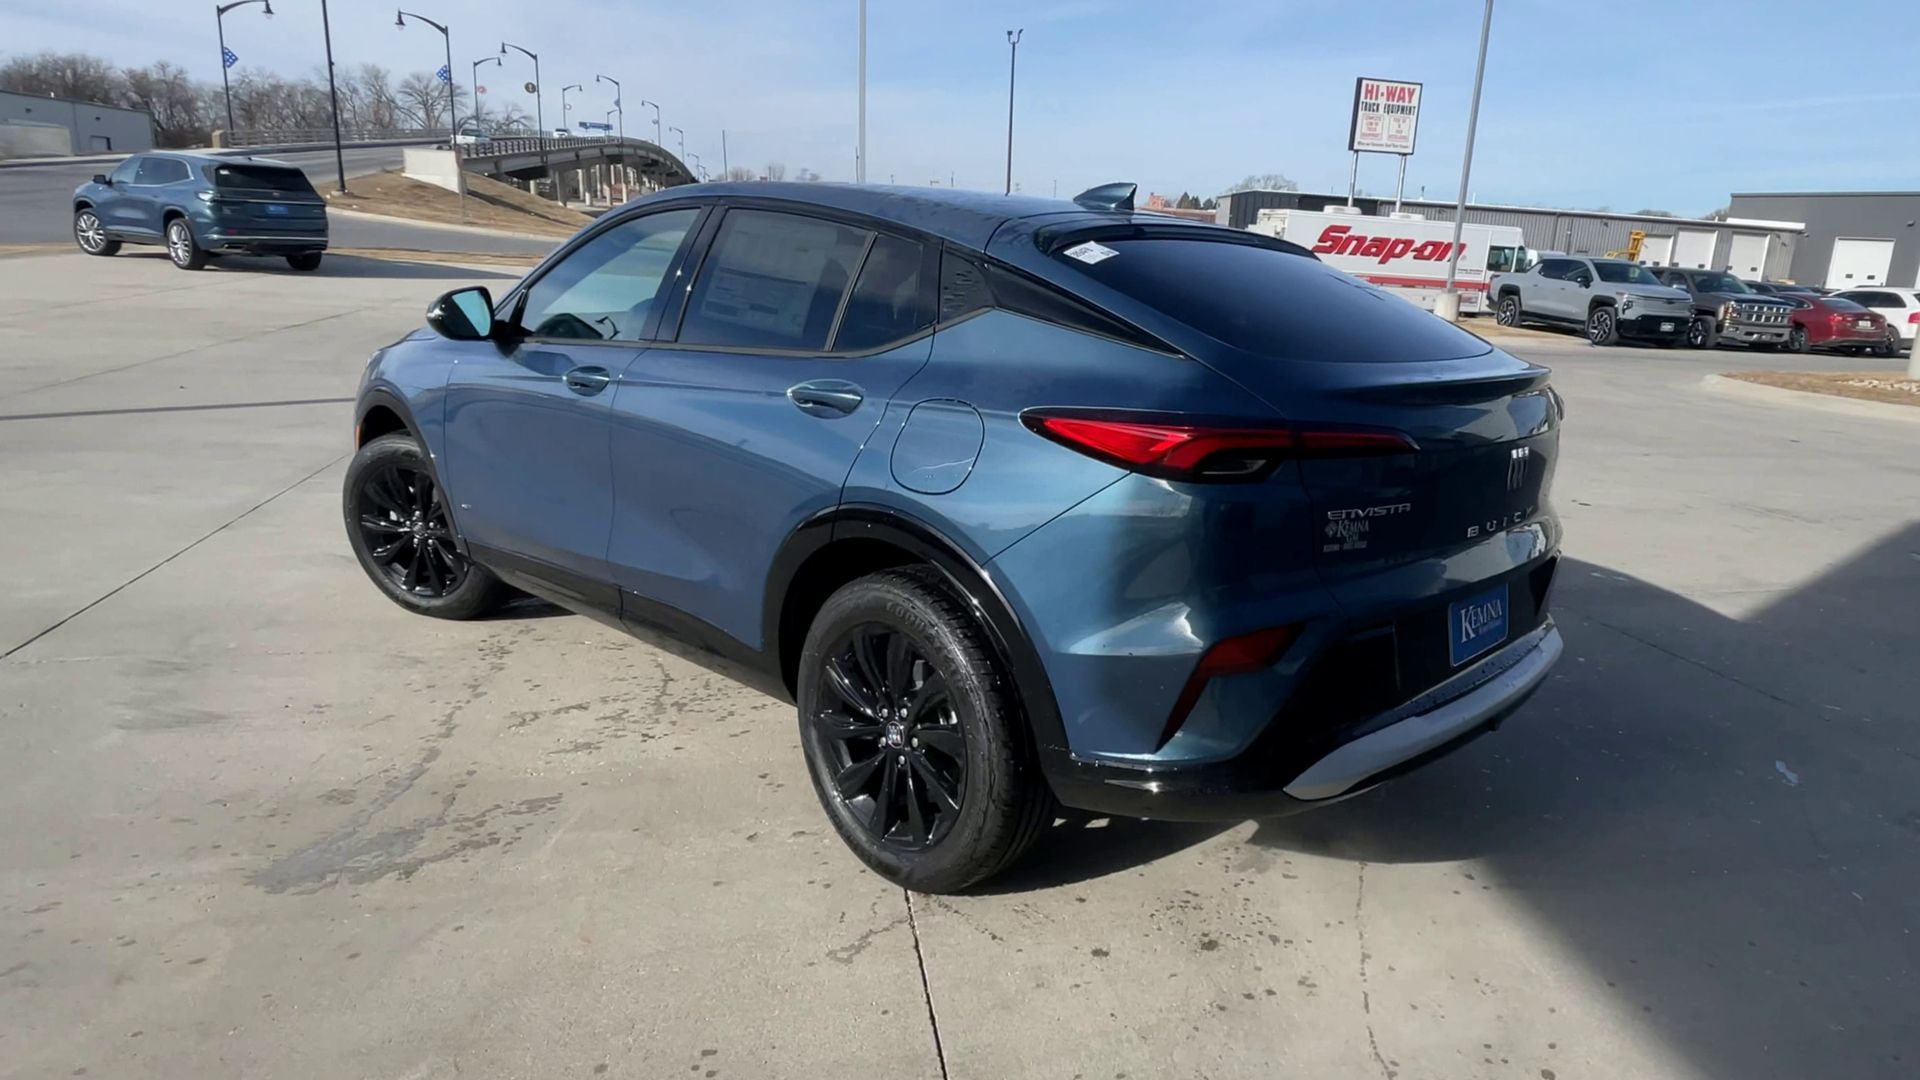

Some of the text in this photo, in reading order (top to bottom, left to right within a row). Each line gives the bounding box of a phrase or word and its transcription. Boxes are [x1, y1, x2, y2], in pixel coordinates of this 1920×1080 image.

[1364, 83, 1416, 104] HI-WAY
[1361, 101, 1416, 116] TRUCK EQUIPMENT
[1312, 225, 1467, 264] Snap-on
[1327, 503, 1411, 520] ENVISTA
[1460, 599, 1503, 643] KEMNA
